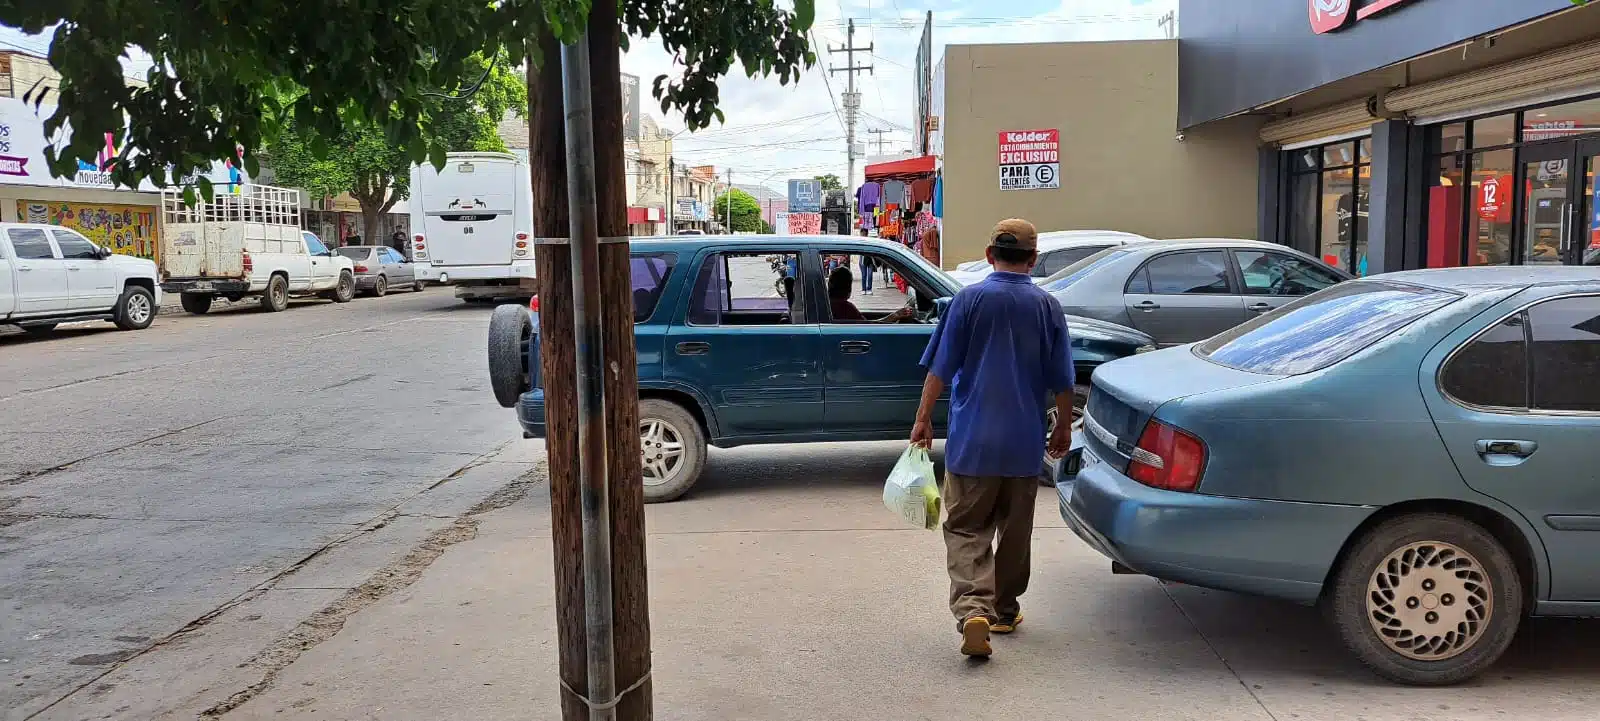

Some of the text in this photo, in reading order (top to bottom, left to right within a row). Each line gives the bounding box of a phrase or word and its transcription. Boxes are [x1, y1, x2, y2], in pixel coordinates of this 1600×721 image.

[1001, 142, 1057, 151] ESTACIONAMIENTO
[1001, 151, 1057, 164] EXCLUSIVO
[1001, 166, 1030, 178] PARA
[1040, 168, 1050, 180] E
[1001, 177, 1031, 186] CLIENTES
[1483, 184, 1496, 204] 12
